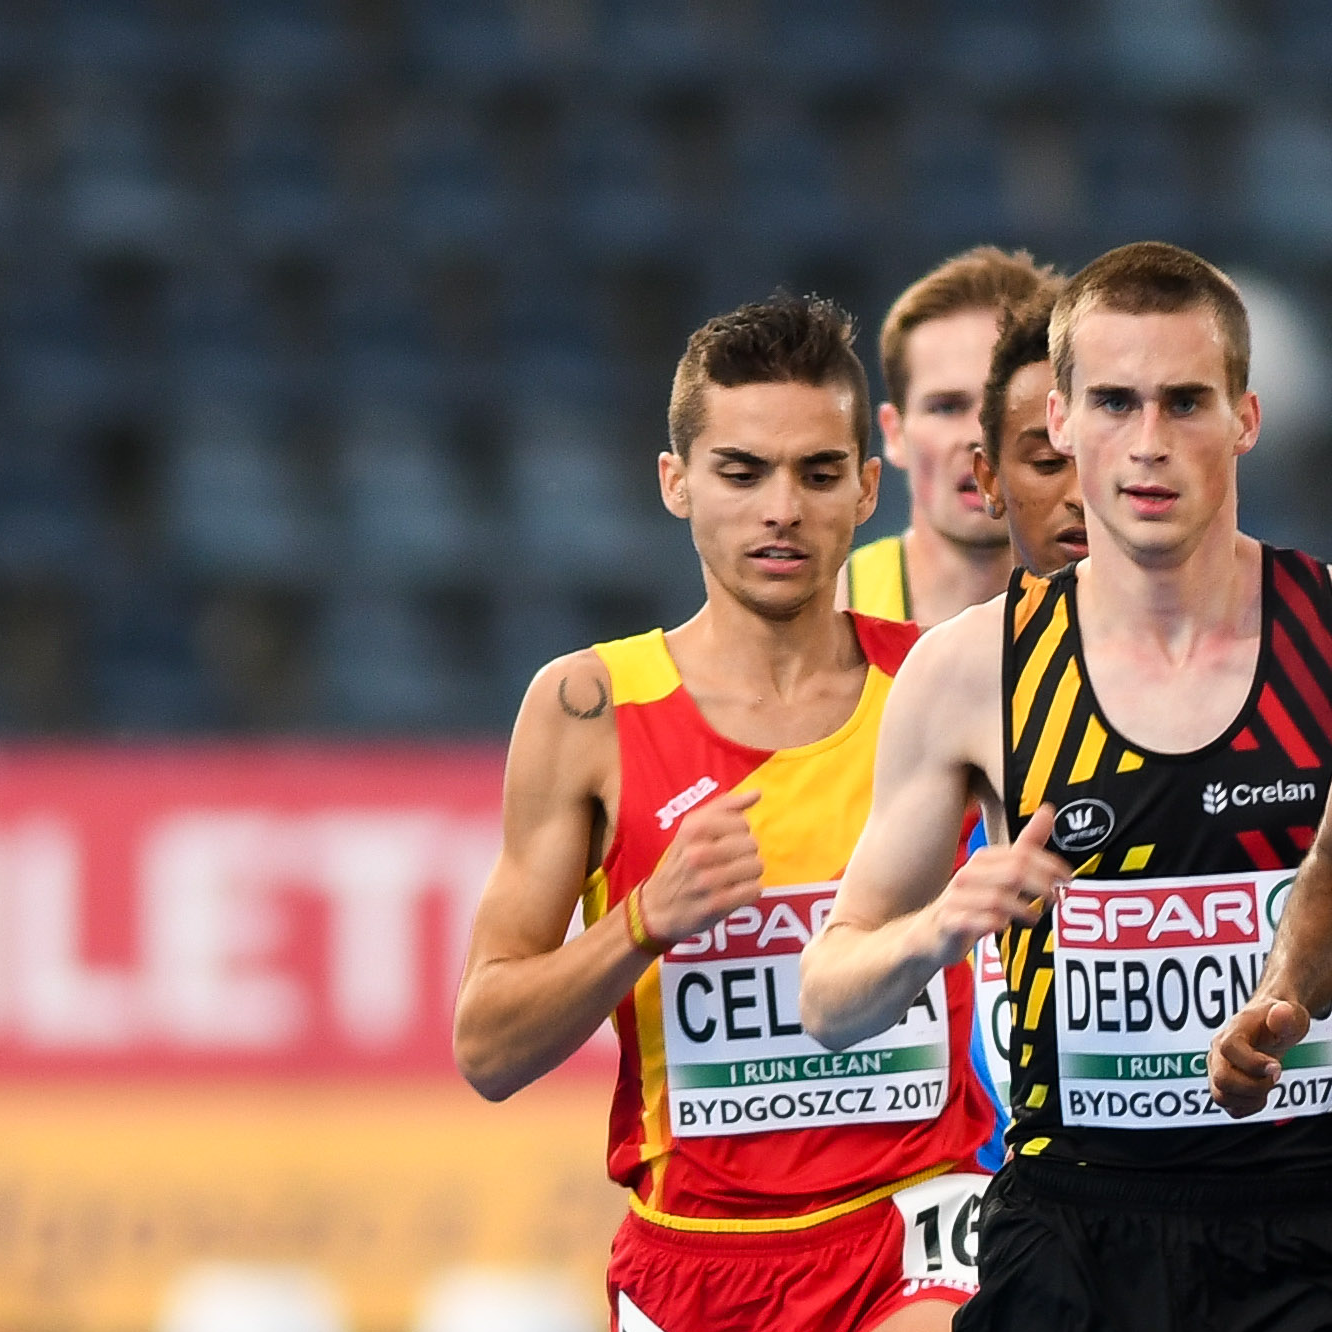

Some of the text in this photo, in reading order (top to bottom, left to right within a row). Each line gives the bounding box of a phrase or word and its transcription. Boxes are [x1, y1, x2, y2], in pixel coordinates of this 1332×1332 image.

[1231, 780, 1317, 807] Crelan
[1061, 889, 1255, 943] SPAR
[676, 964, 938, 1044] CELA
[729, 1064, 737, 1085] I
[744, 1059, 796, 1084] RUN
[1117, 1057, 1124, 1078] I
[1131, 1055, 1183, 1078] RUN
[679, 1080, 944, 1126] BYDGOSZCZ 2017
[914, 1193, 983, 1273] 16
